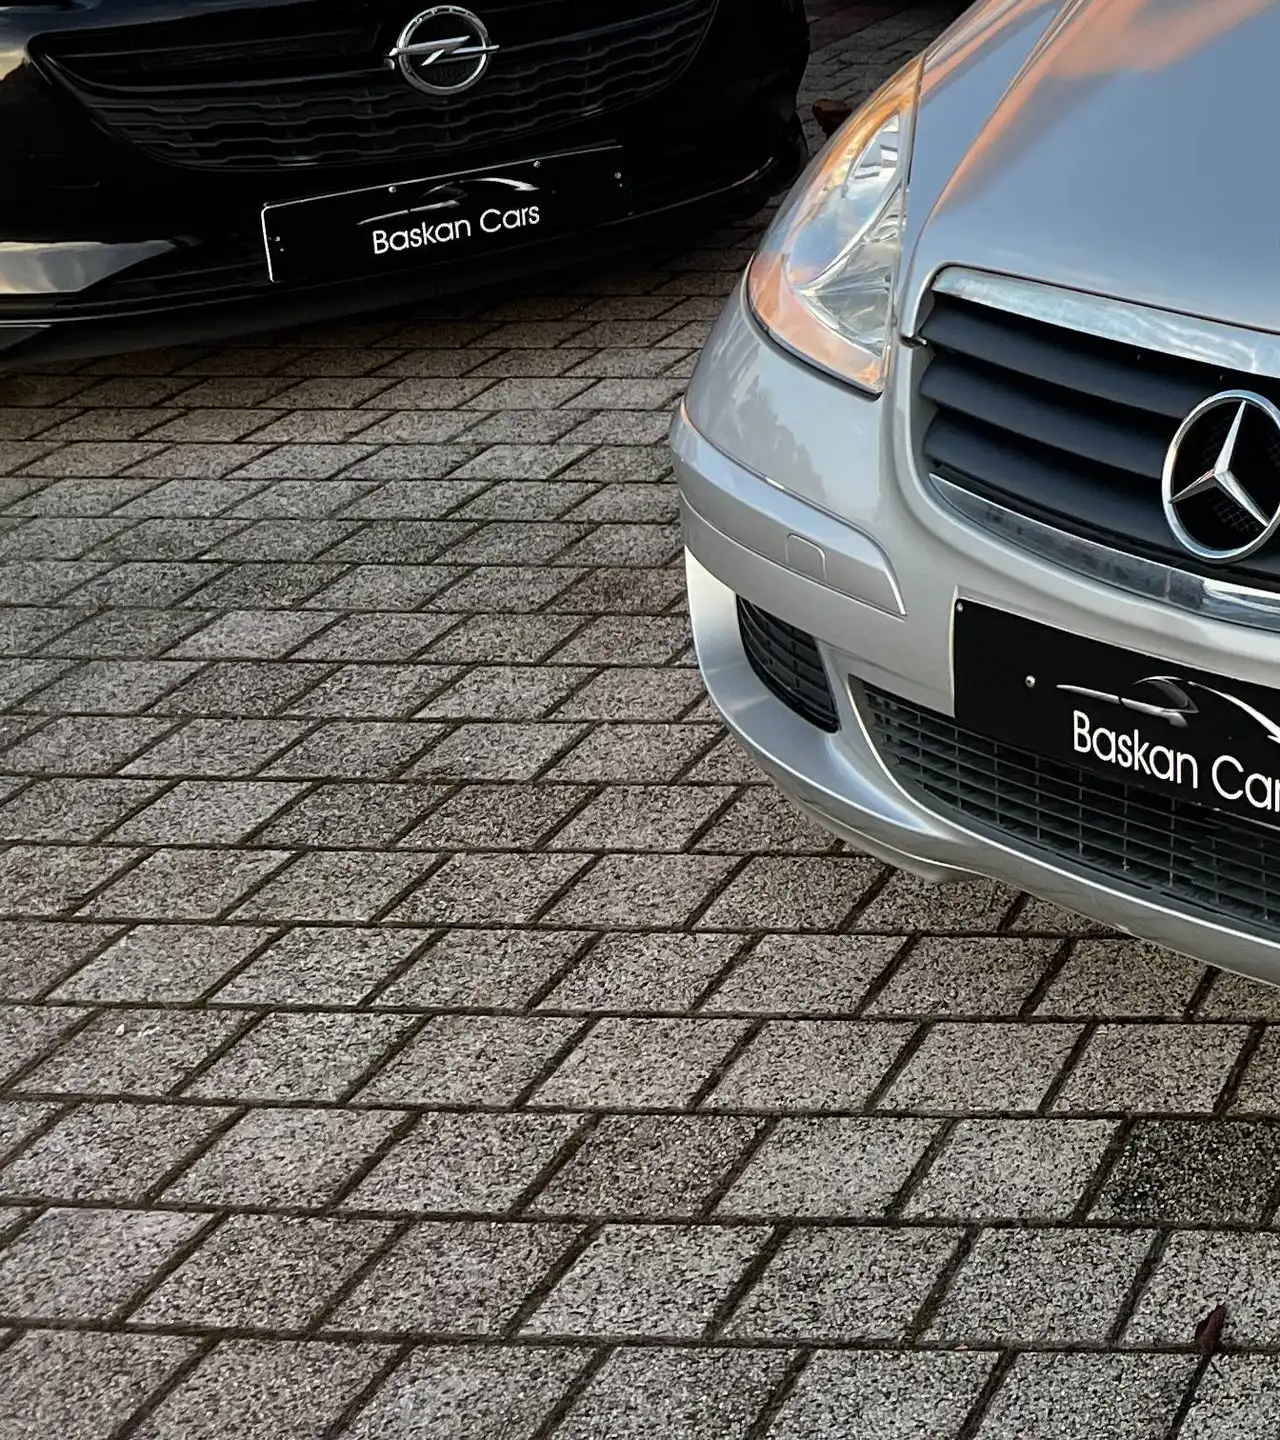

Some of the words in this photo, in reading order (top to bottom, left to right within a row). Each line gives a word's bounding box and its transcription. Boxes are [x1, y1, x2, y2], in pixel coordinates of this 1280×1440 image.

[372, 217, 472, 255] Baskan
[479, 205, 540, 233] Cars
[1073, 710, 1198, 789] Baskan
